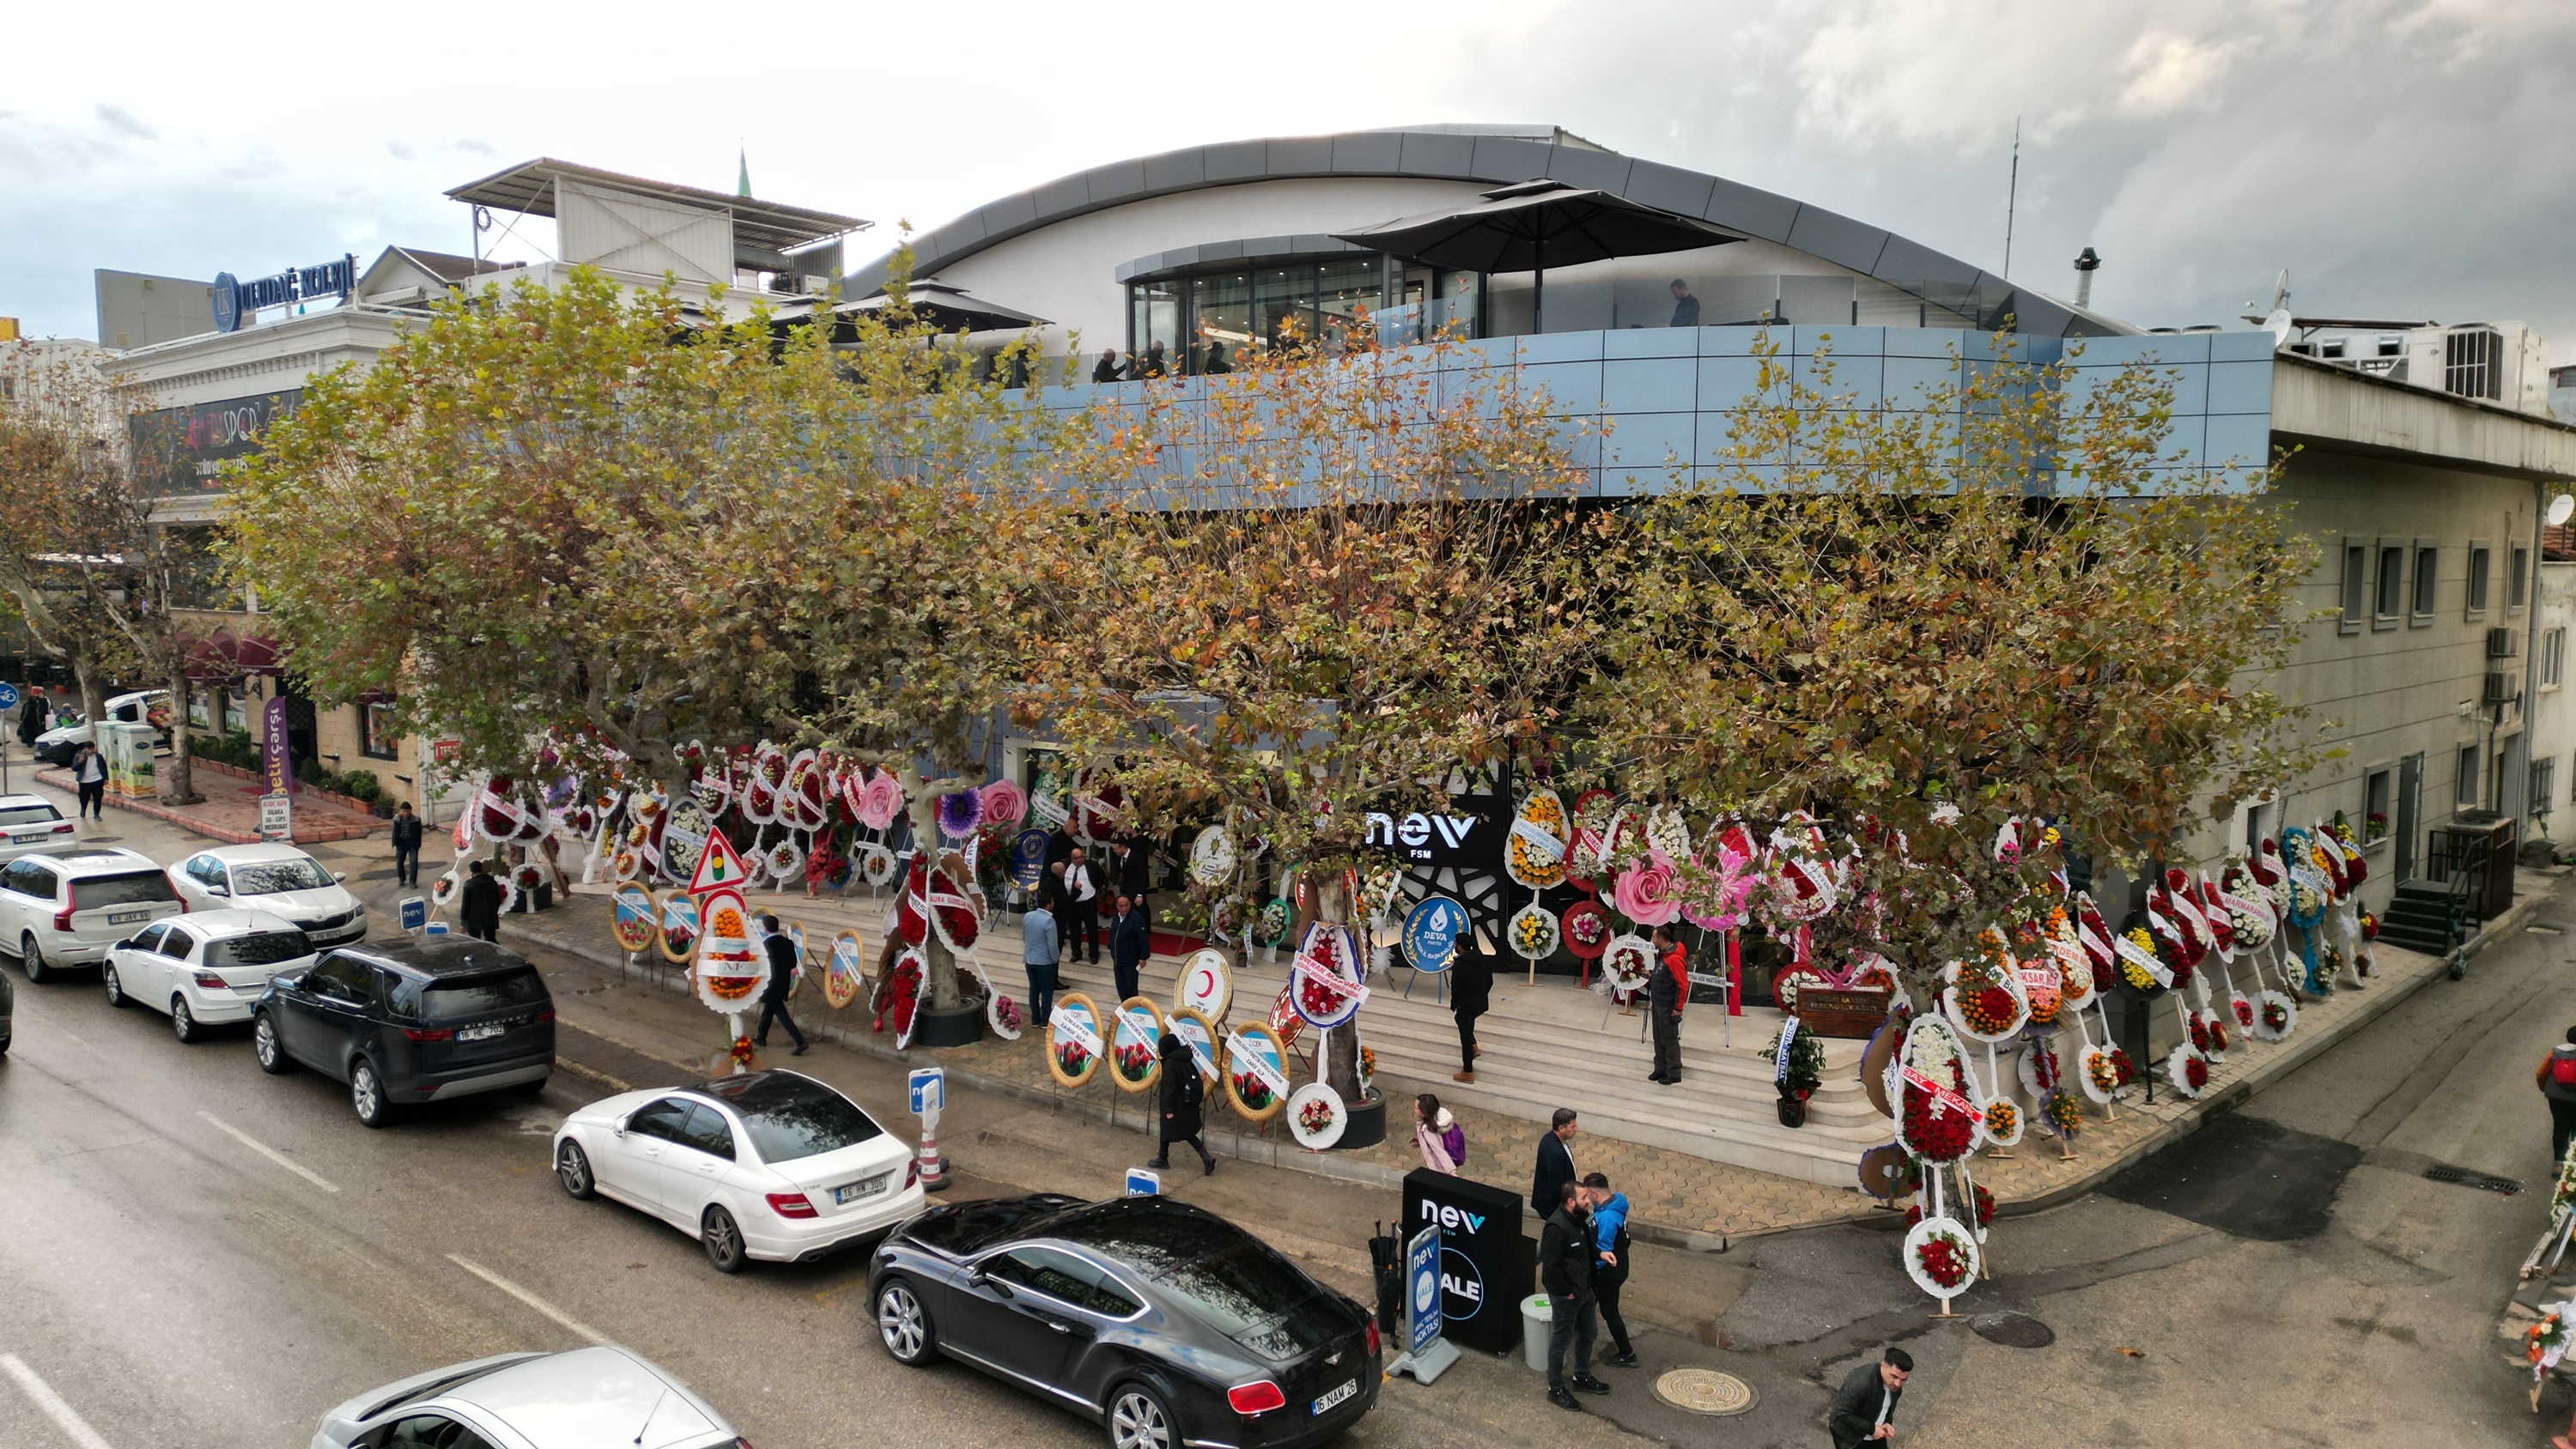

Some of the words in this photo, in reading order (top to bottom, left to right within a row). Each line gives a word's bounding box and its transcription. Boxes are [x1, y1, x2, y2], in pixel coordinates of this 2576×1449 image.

[240, 267, 298, 310] ULUDAĞ
[301, 252, 355, 298] KOLEJİ
[1365, 812, 1477, 849] new
[1585, 833, 1603, 852] BURCU
[1411, 850, 1431, 858] FSM
[139, 911, 149, 919] 99
[1424, 931, 1447, 941] DEVA
[1427, 940, 1455, 960] BAŞKANLIĞ
[2124, 950, 2142, 962] FSM
[2125, 941, 2161, 968] WIMBLEDON
[1810, 1003, 1855, 1011] FARKINDALIK
[465, 1016, 528, 1029] DISCOVERY
[461, 1031, 470, 1040] 16
[489, 1025, 503, 1034] 702
[1075, 1034, 1086, 1043] ALP
[1779, 1048, 1789, 1079] MATBAA
[844, 1189, 853, 1197] 16
[869, 1178, 884, 1190] 306
[1422, 1199, 1485, 1234] new
[1413, 1242, 1436, 1271] new
[1417, 1282, 1433, 1300] VALE
[1441, 1273, 1480, 1301] ALE
[1424, 1309, 1438, 1324] TESLİM
[1415, 1318, 1439, 1346] NOKTASI
[1316, 1398, 1325, 1412] 16
[1327, 1387, 1345, 1407] NAM
[1346, 1380, 1356, 1396] 26
